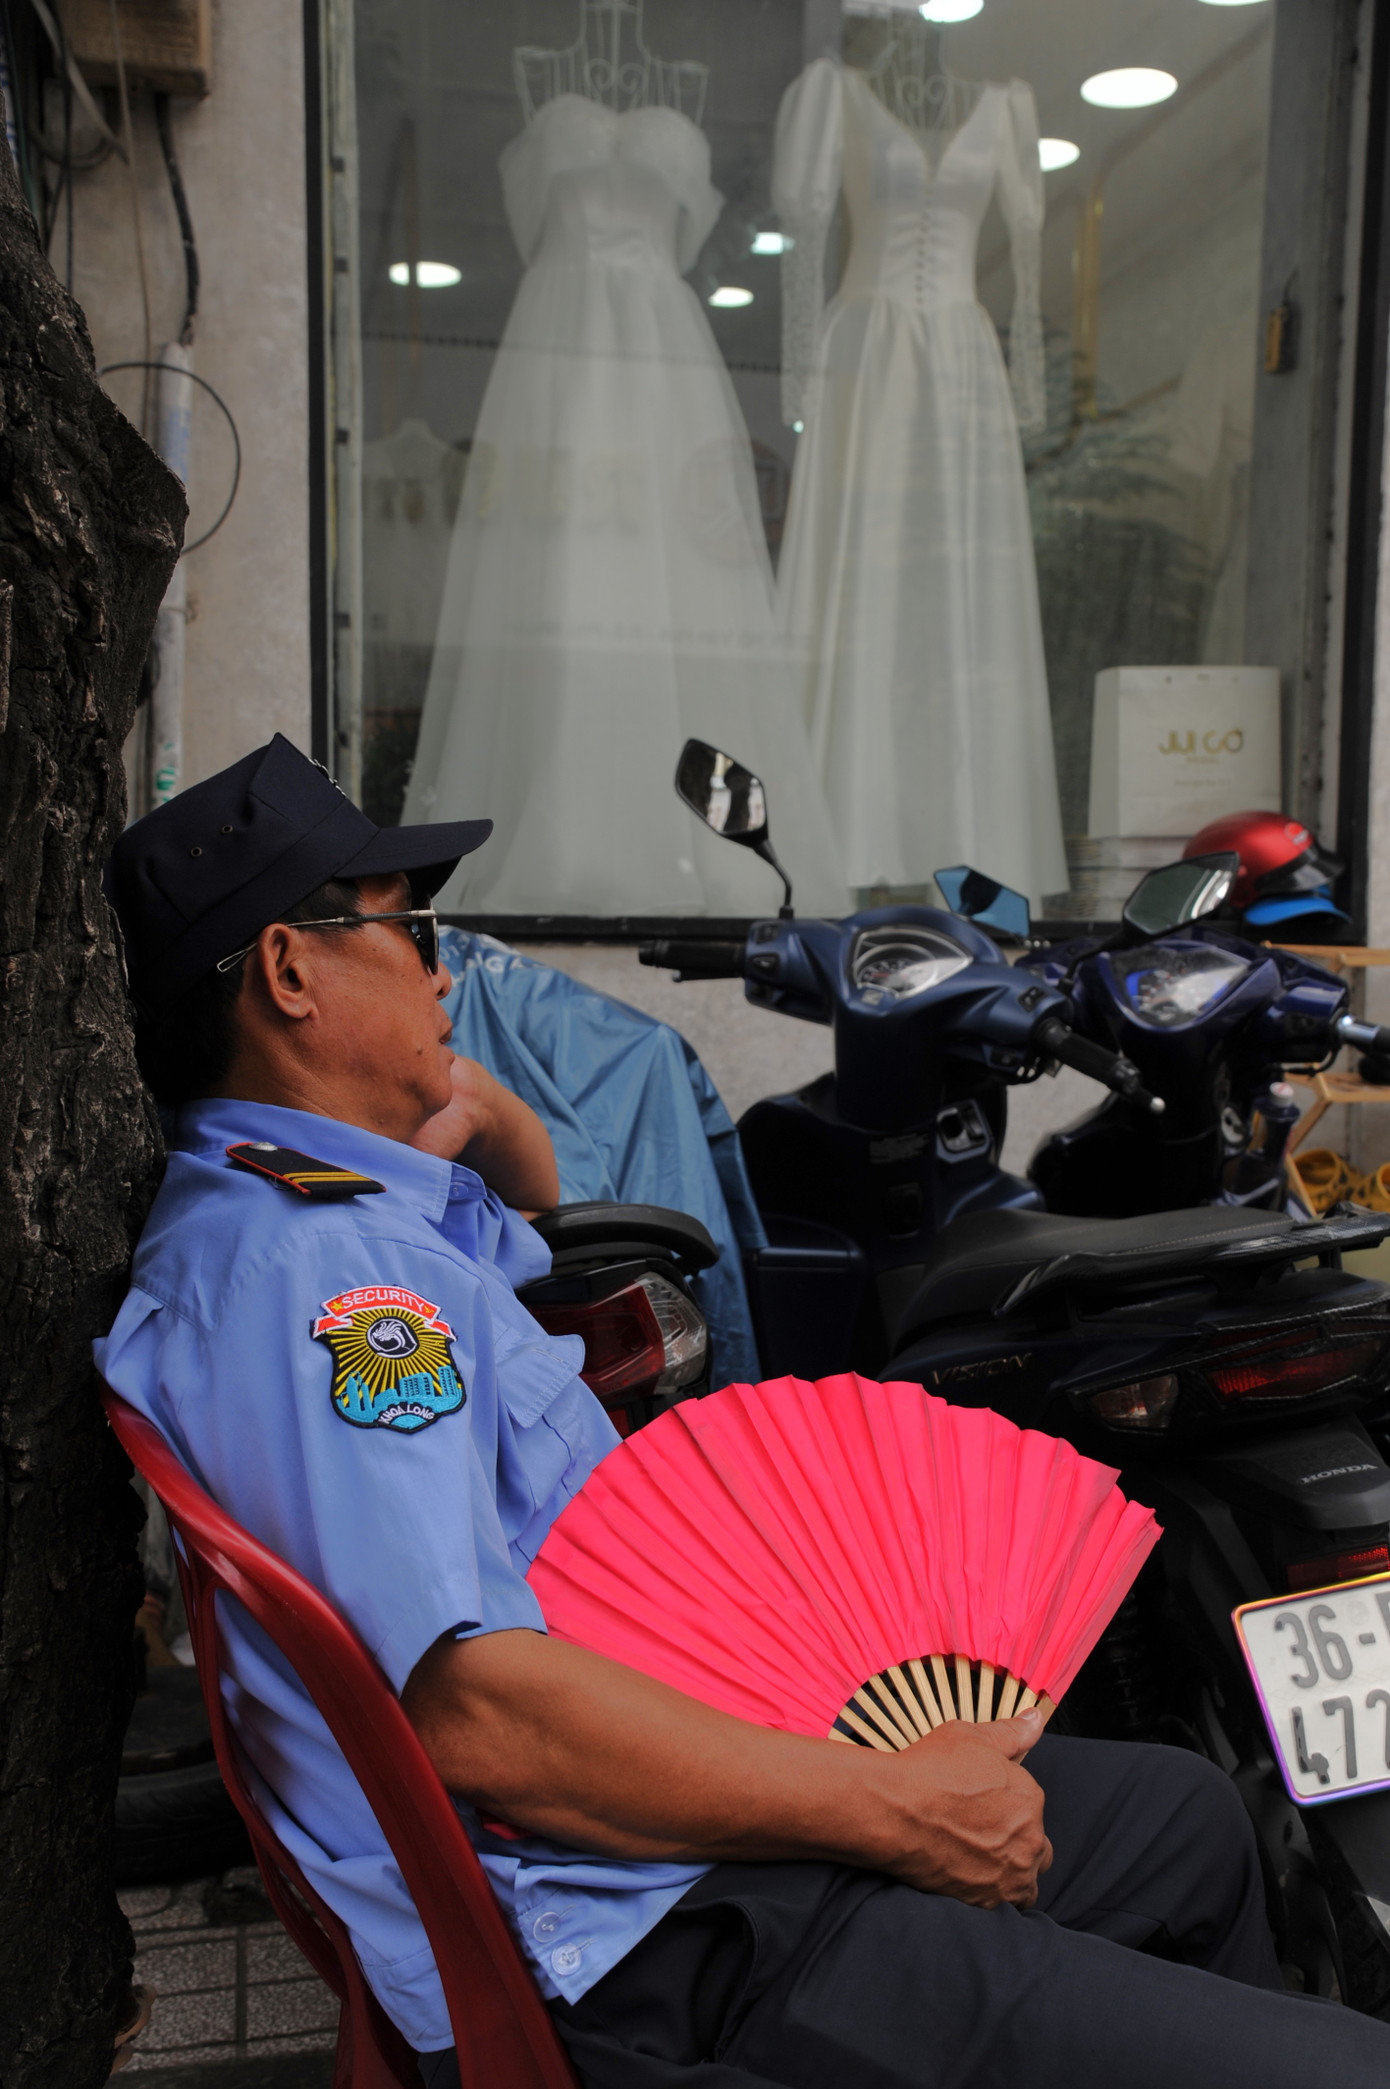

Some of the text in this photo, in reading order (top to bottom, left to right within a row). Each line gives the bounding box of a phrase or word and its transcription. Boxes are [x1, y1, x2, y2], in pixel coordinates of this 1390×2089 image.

[341, 1289, 425, 1312] SECURITY
[931, 1352, 1032, 1385] VISION
[378, 1403, 435, 1425] KHOA LONG
[1300, 1463, 1378, 1484] HONDA
